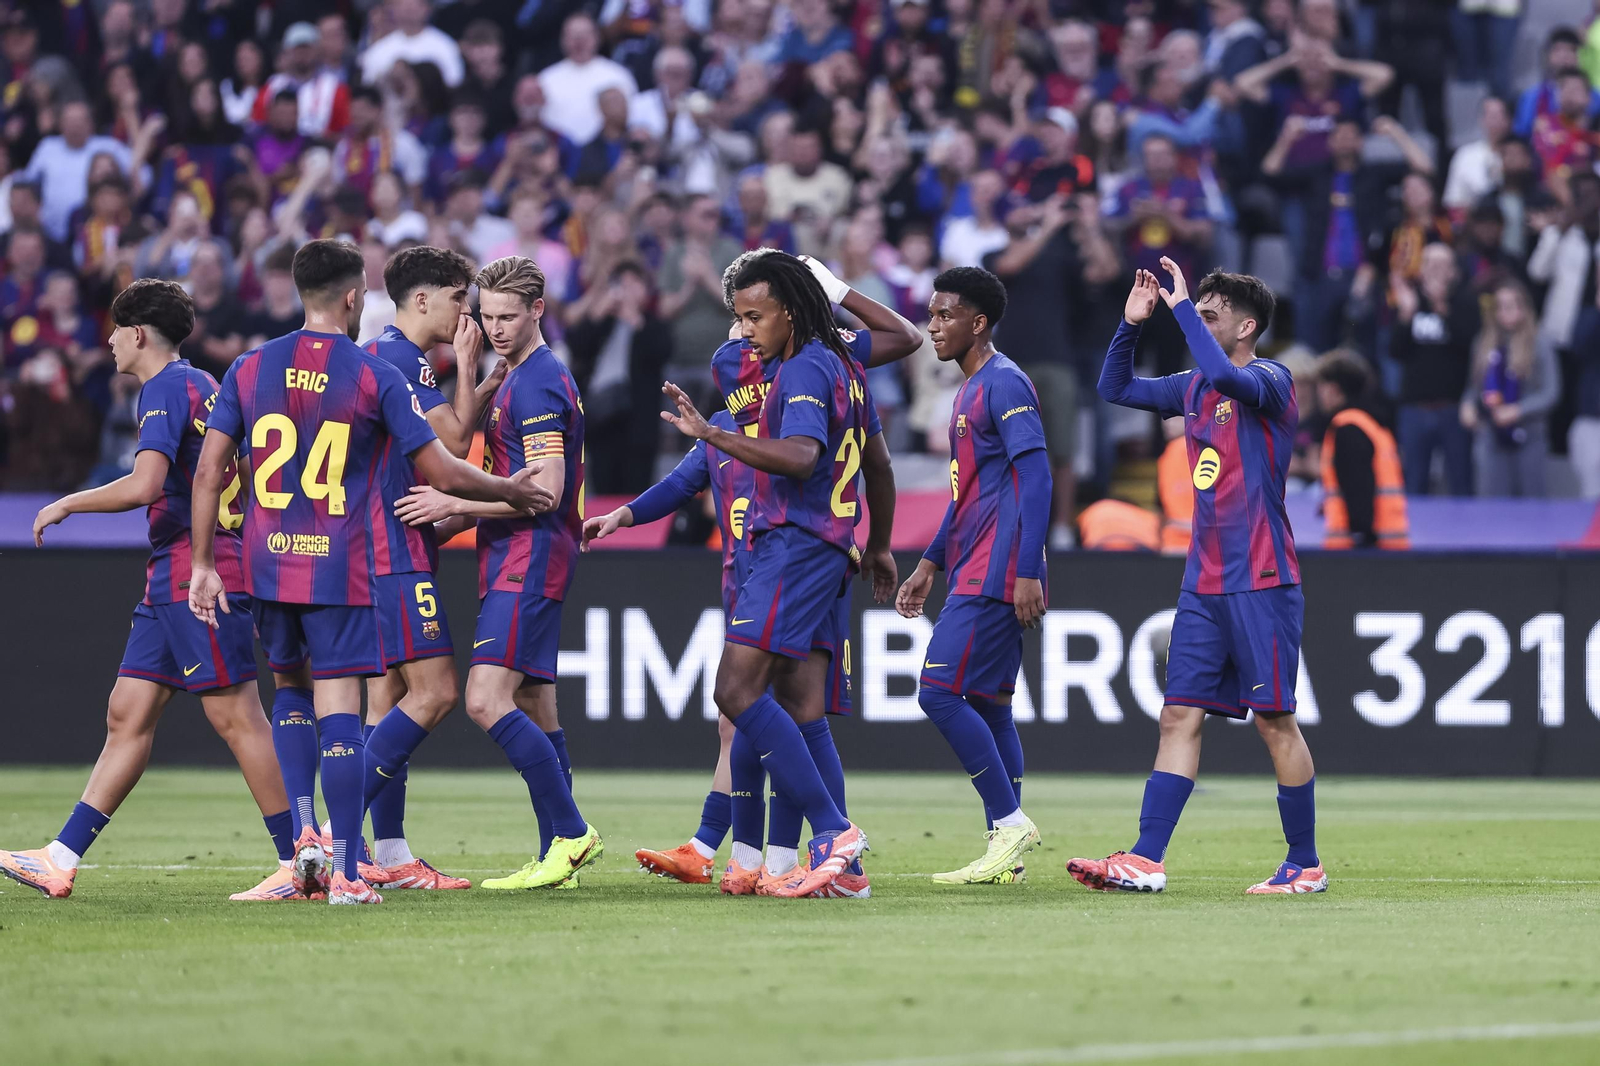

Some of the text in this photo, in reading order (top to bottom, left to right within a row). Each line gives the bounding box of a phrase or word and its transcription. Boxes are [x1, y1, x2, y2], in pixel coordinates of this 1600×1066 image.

[286, 368, 329, 393] ERIC
[522, 413, 554, 427] AMBILIGHT
[251, 412, 349, 516] 24
[291, 542, 330, 553] ACNUR
[292, 533, 330, 545] UNHCR
[414, 581, 437, 618] 5
[1352, 609, 1600, 728] 321
